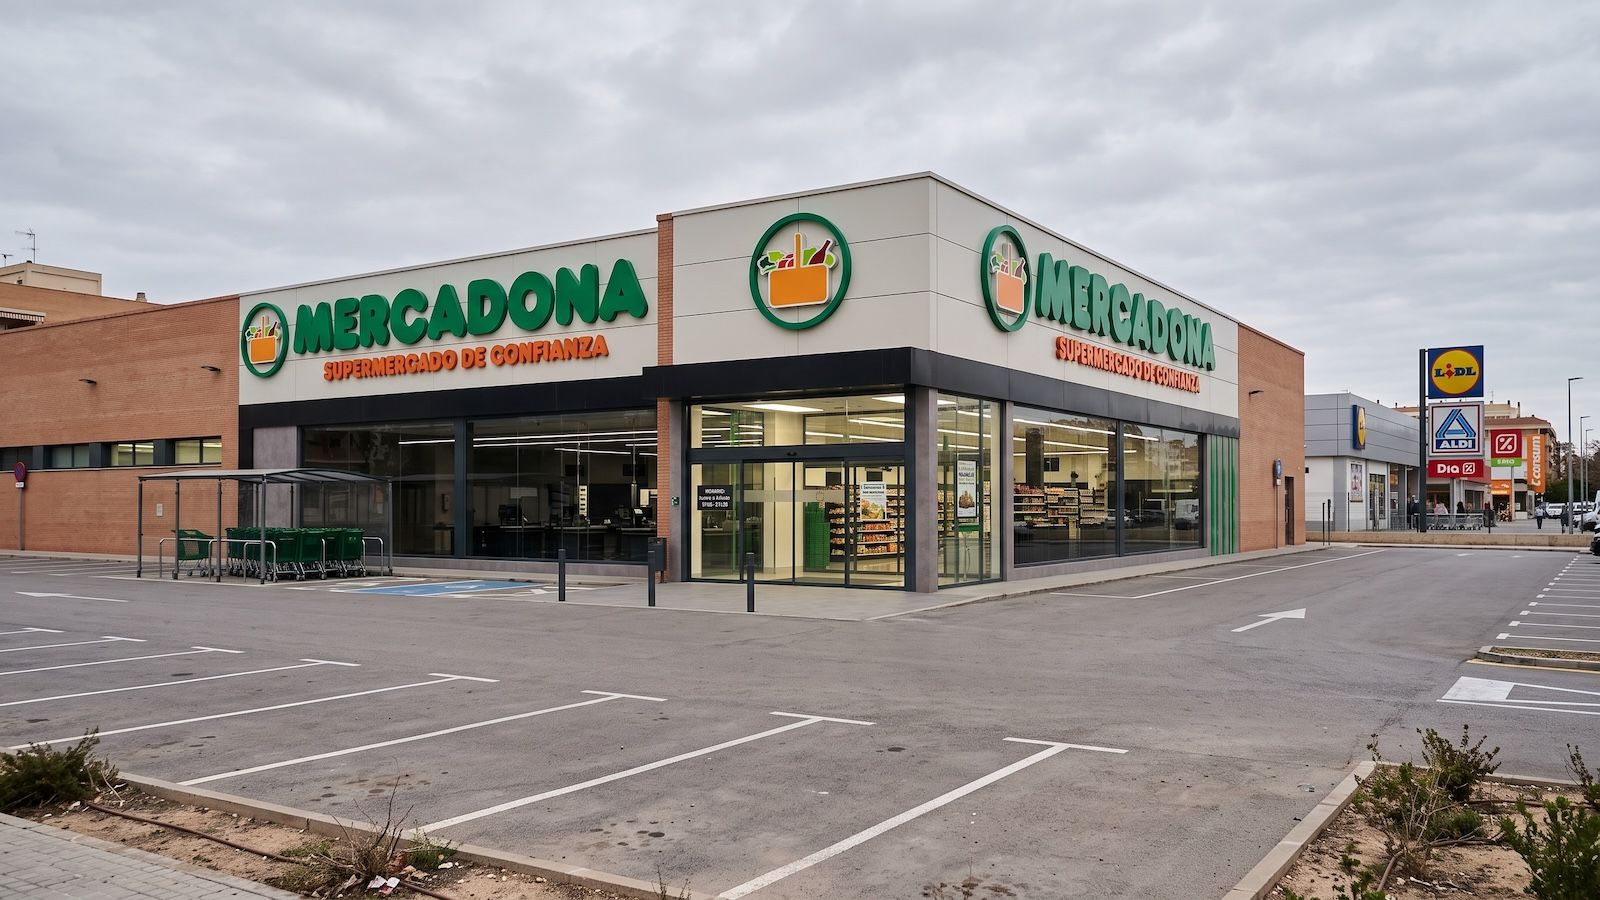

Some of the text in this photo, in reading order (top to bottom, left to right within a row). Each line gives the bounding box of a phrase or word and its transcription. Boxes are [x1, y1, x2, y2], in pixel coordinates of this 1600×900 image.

[293, 258, 649, 354] MERCADONA
[1035, 252, 1216, 371] MERCADONA
[323, 334, 609, 381] SUPERMERCADO DE CONFIANZA
[1056, 335, 1200, 393] SUPERMERCADO DE CONFIANZA
[1440, 440, 1473, 449] ALDI
